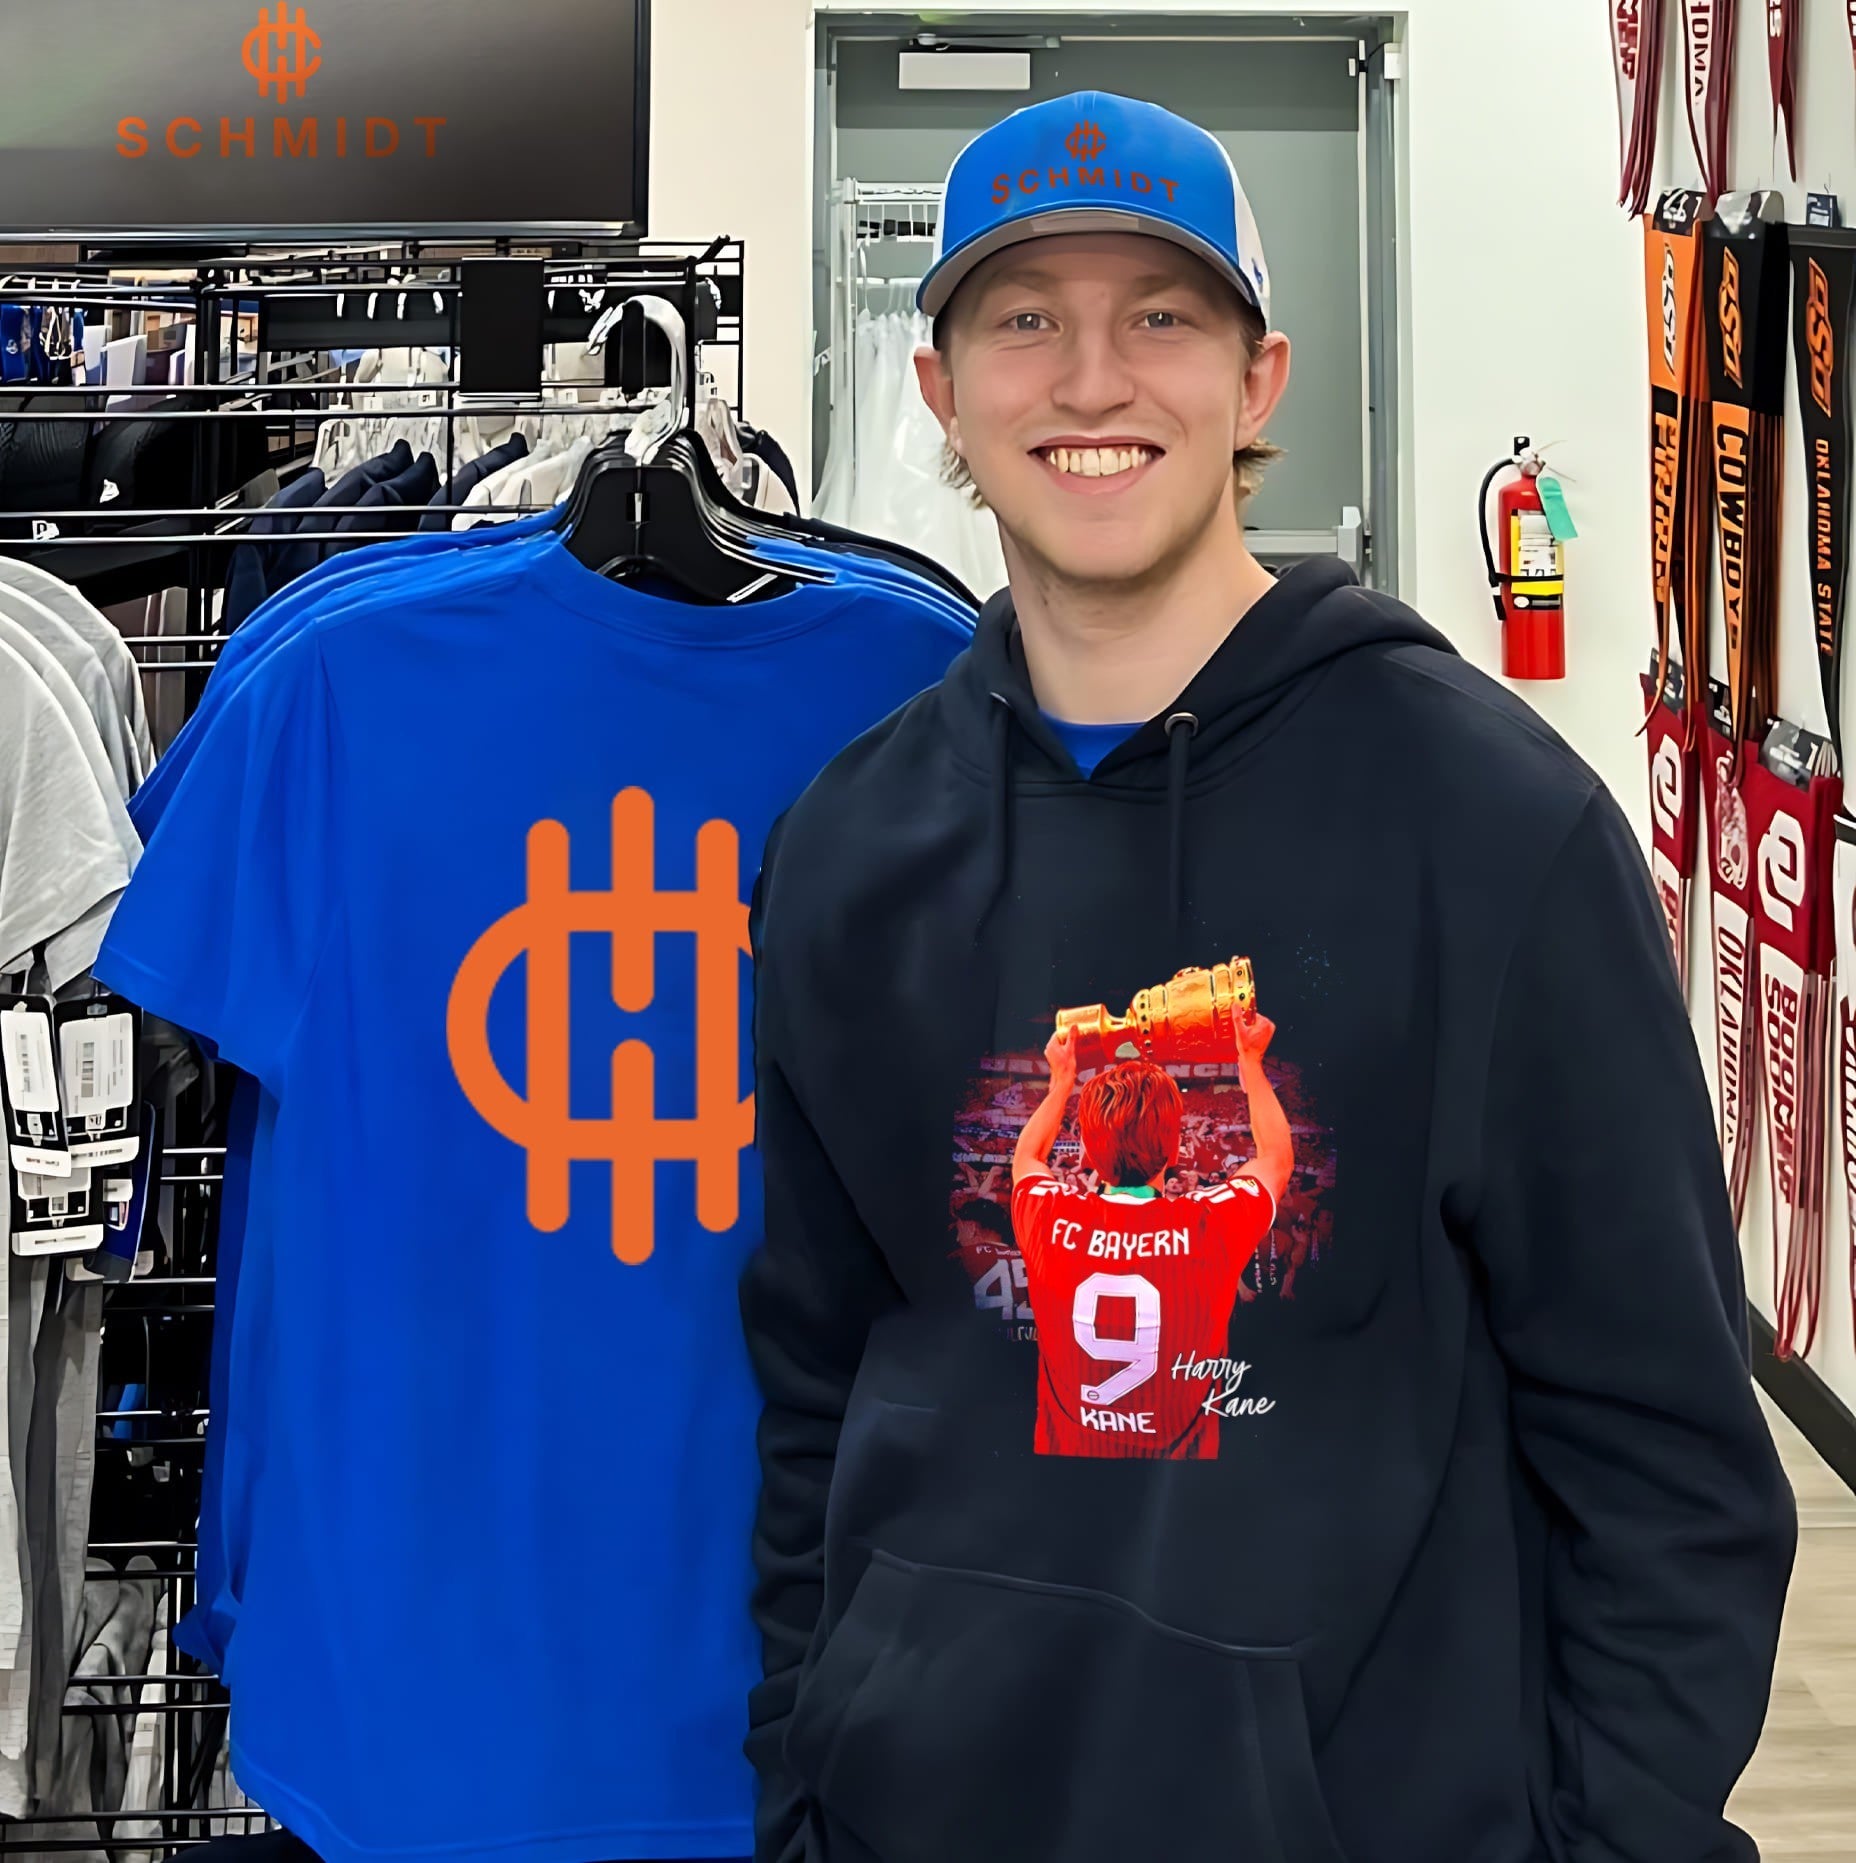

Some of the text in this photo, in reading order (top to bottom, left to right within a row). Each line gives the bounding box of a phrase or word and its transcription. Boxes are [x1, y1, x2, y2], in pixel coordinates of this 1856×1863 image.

[115, 116, 448, 159] SCHMIDT
[991, 166, 1179, 205] SCHMIDT
[1815, 438, 1832, 571] OKLAHOMA
[1051, 1218, 1190, 1261] FC BAYERN
[1072, 1271, 1161, 1406] 9
[1171, 1350, 1252, 1394] Harry
[1079, 1406, 1157, 1434] KANE
[1202, 1387, 1277, 1418] Kane
